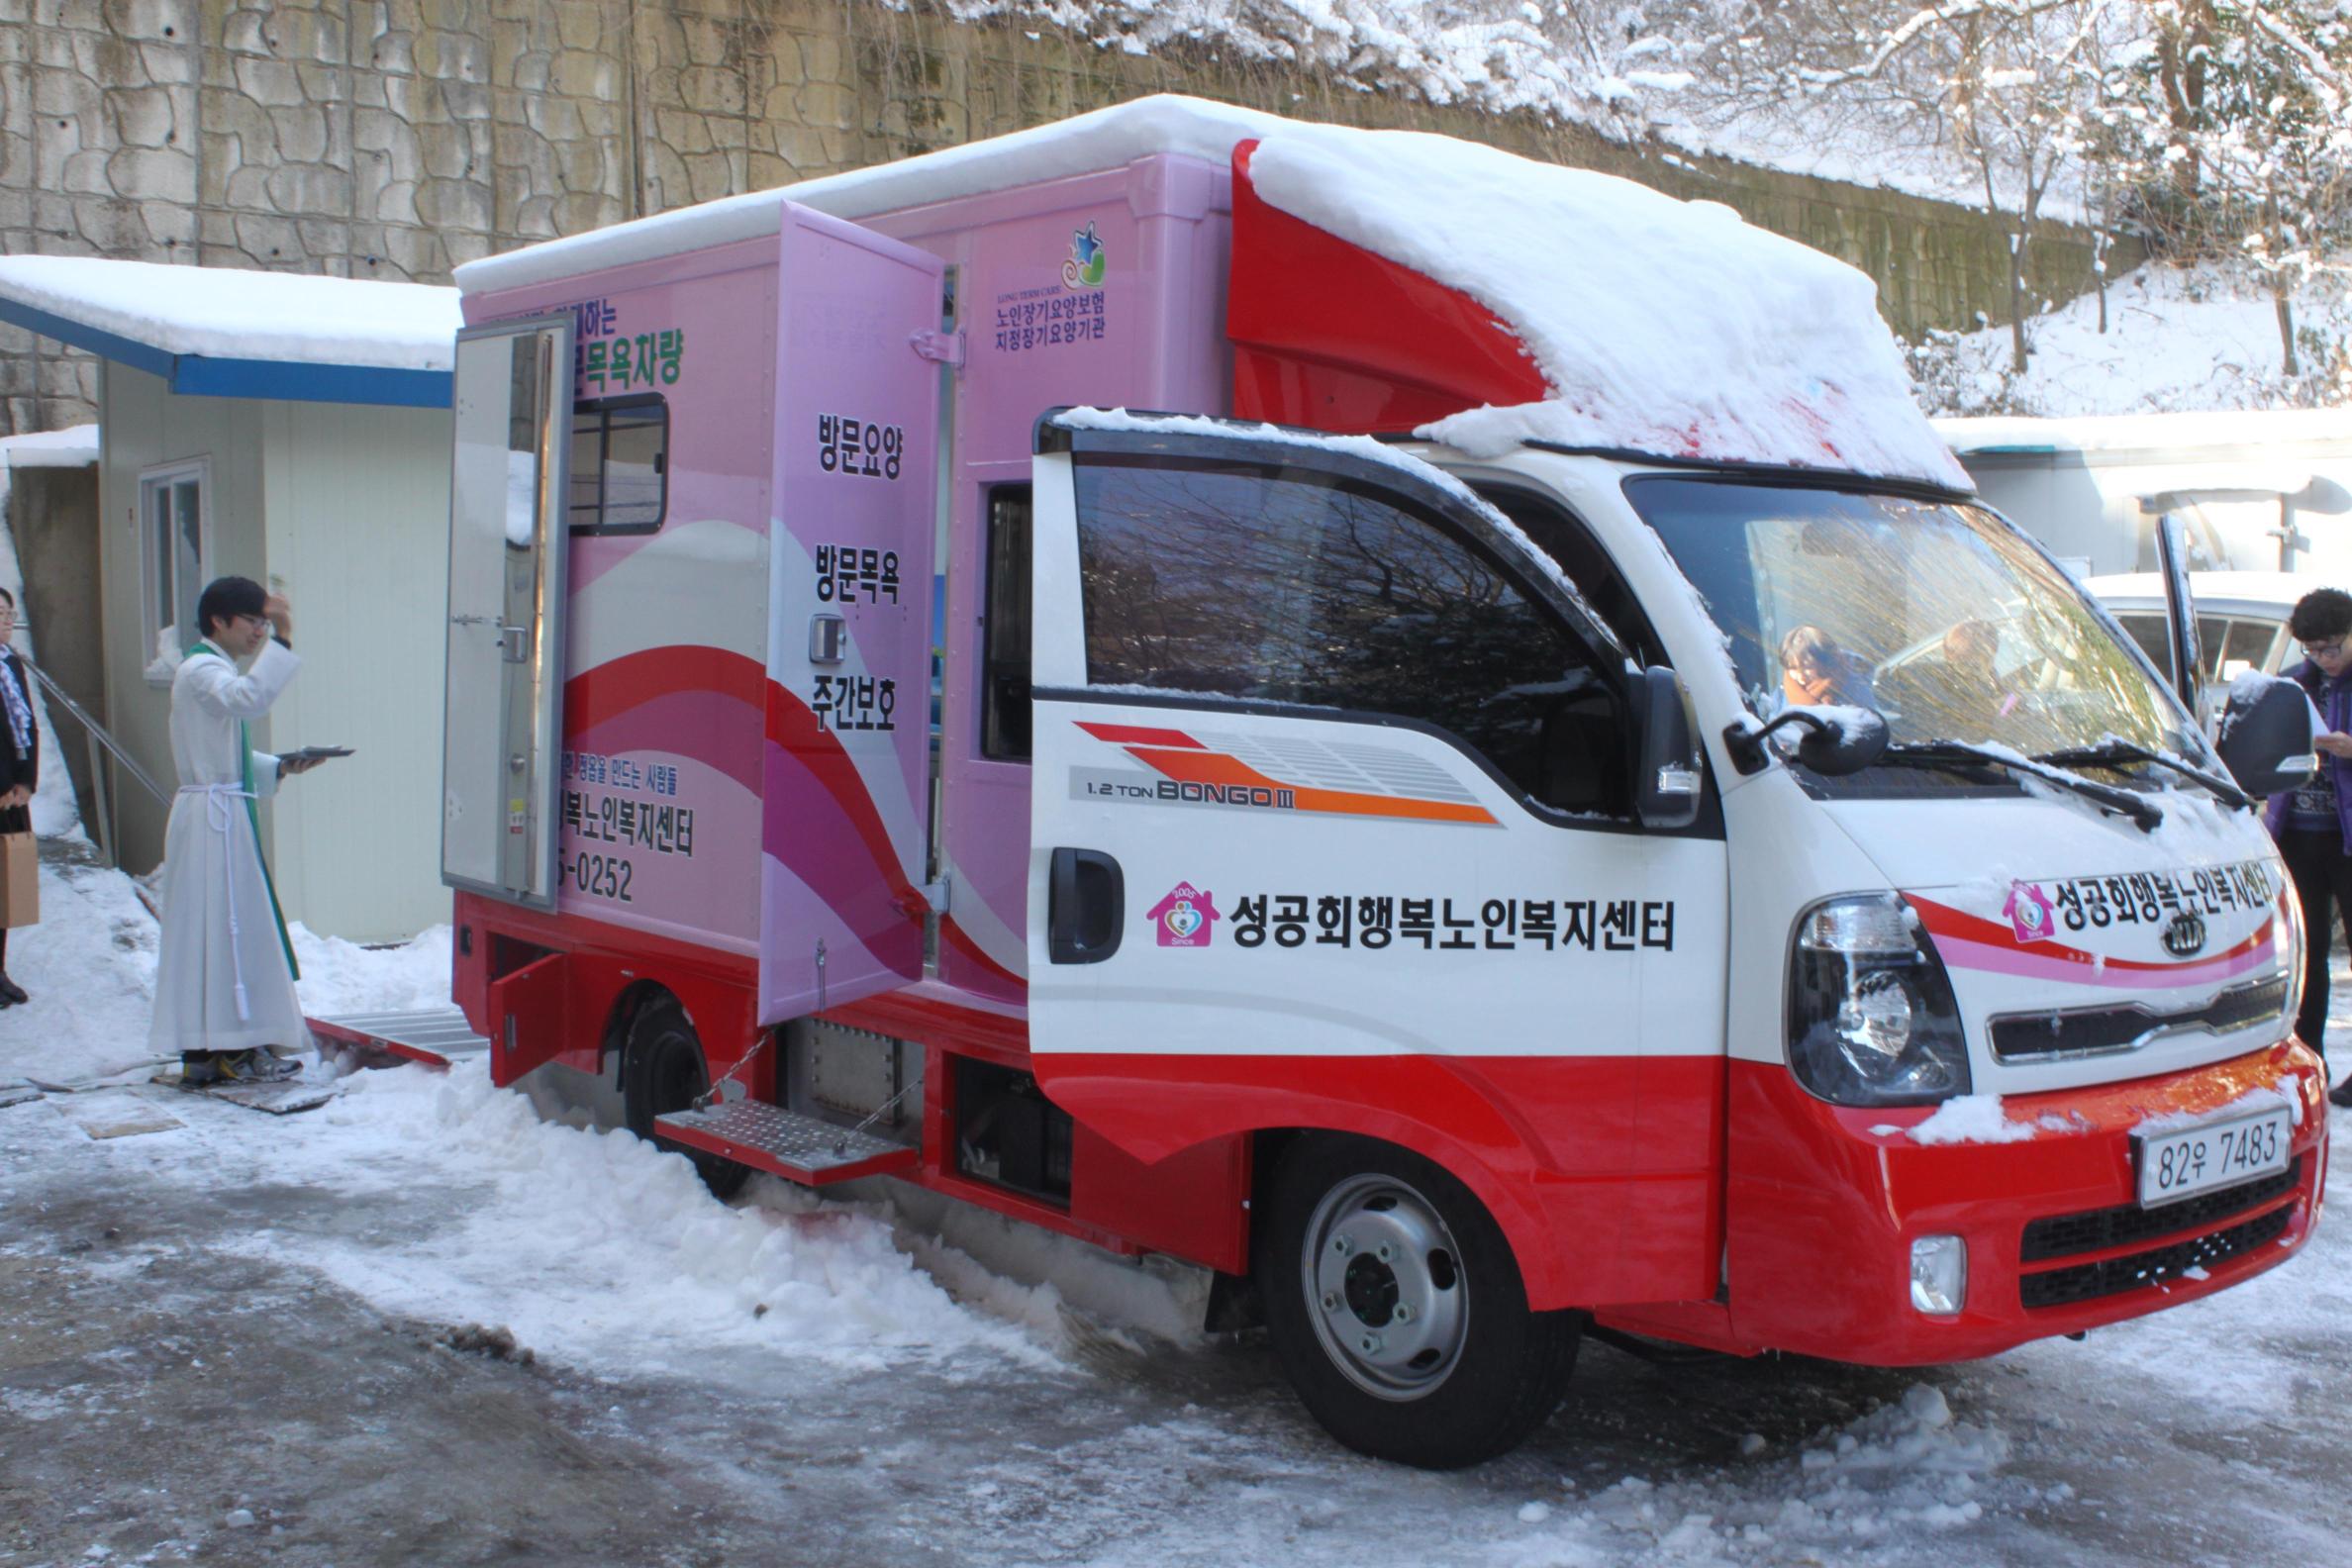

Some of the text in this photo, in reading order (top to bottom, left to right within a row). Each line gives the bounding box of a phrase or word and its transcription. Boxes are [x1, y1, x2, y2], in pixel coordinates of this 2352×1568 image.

[996, 291, 1105, 328] 노인장기요양보험
[996, 316, 1106, 351] 지정장기요양기관
[819, 414, 904, 480] 방문요양
[816, 544, 900, 606] 방문목욕
[812, 675, 895, 731] 주간보호
[611, 759, 641, 790] 만드는
[646, 763, 678, 796] 사람들
[1088, 782, 1114, 796] 1.2
[1117, 785, 1154, 799] TON
[1156, 780, 1273, 808] BONGO
[559, 788, 694, 858] 복노인복지센터
[1229, 894, 1675, 951] 성공회행복노인복지센터
[2056, 860, 2275, 931] 성공회행복노인복지센터
[2158, 1121, 2277, 1189] 82우 7483
